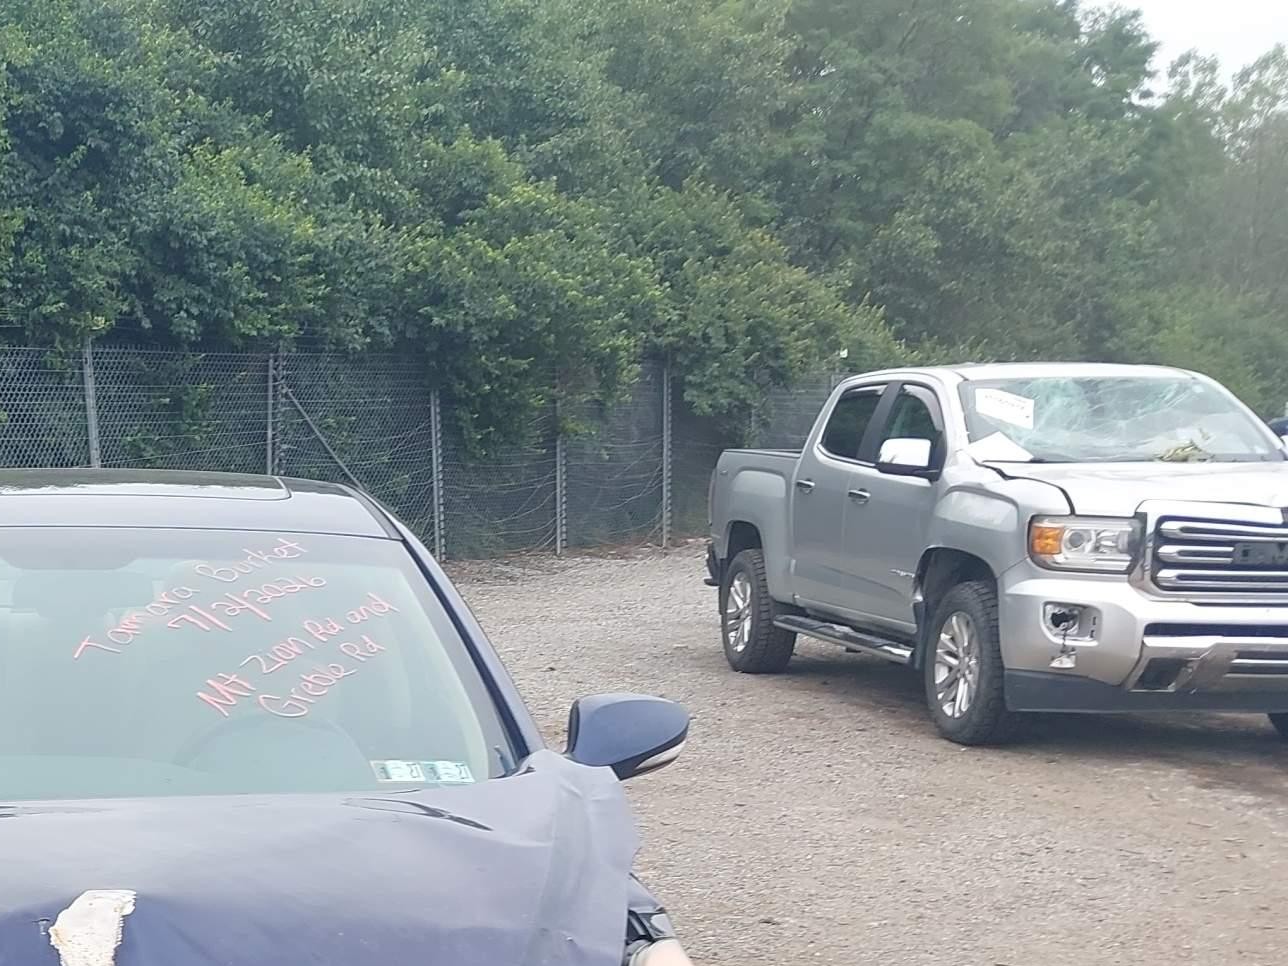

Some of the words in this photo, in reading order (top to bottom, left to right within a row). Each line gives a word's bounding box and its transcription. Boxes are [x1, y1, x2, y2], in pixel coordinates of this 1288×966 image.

[73, 584, 201, 660] Tamara
[168, 576, 328, 632] 7/2/2026
[197, 673, 257, 718] Mt
[240, 636, 315, 675] Zion
[304, 618, 345, 643] Rd
[345, 592, 400, 625] and
[339, 635, 386, 662] Rd
